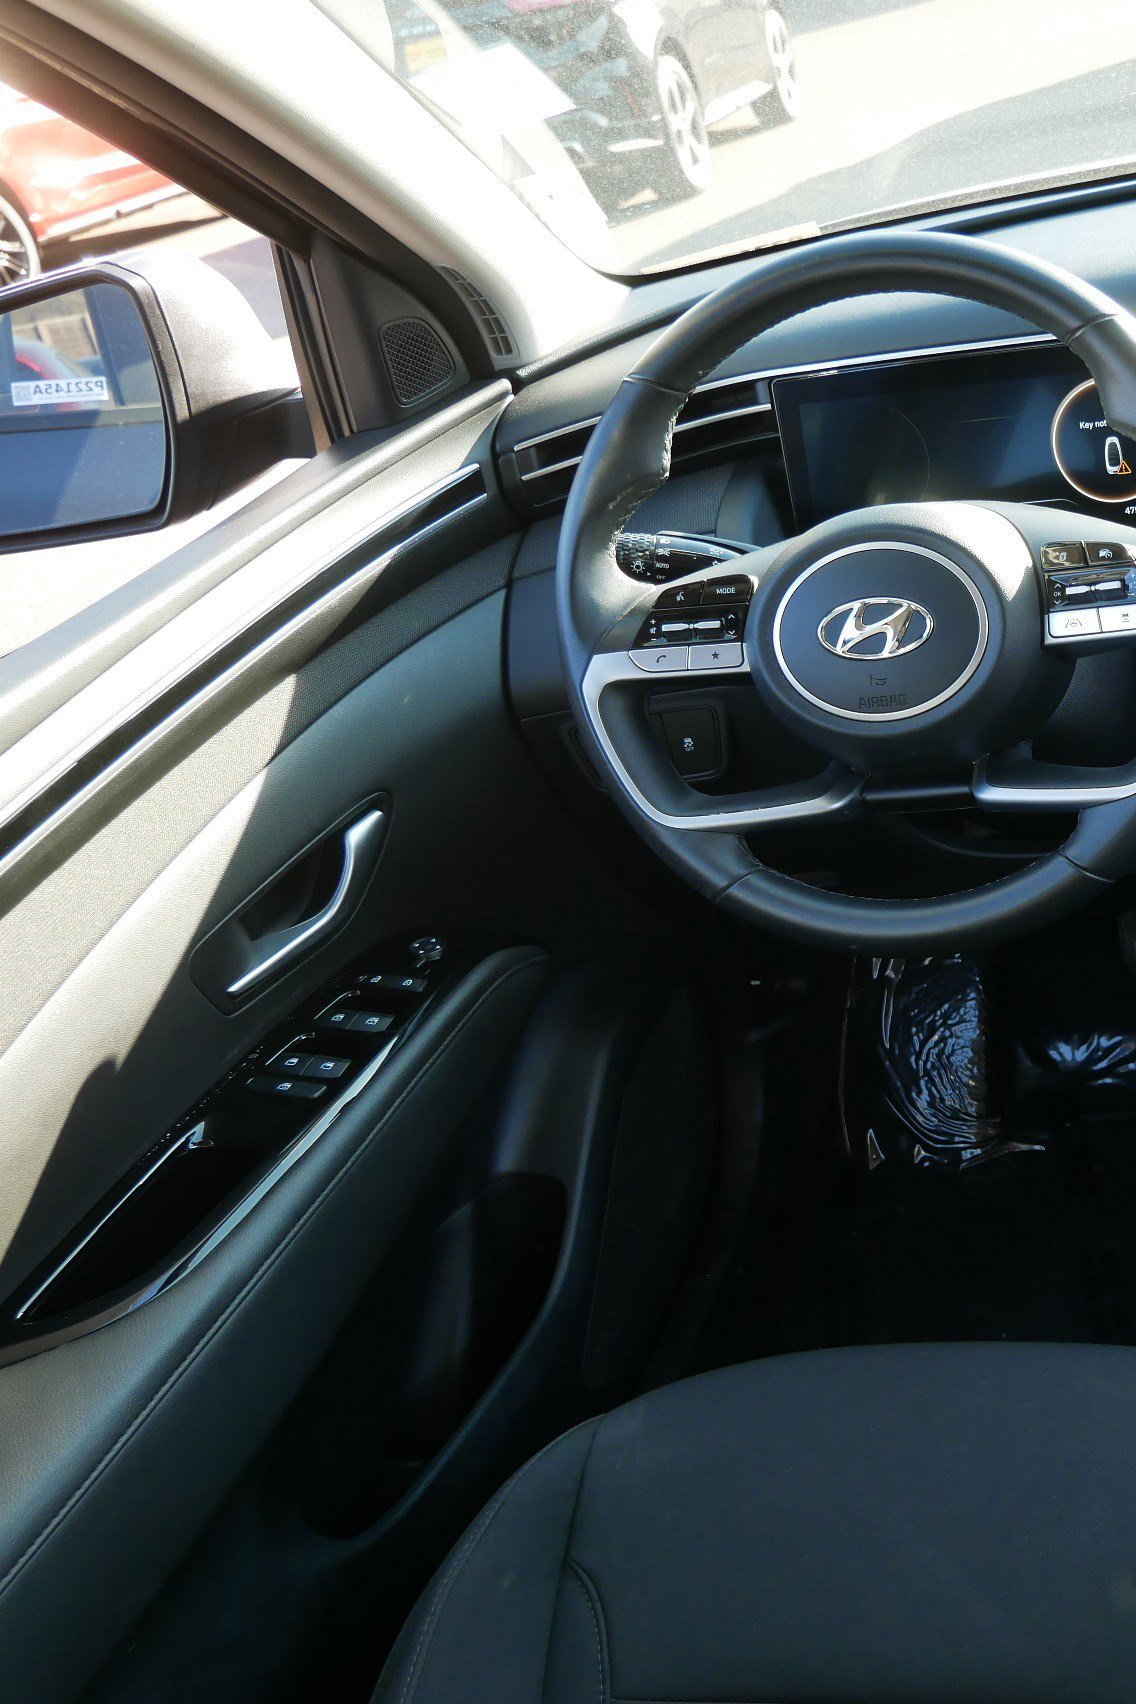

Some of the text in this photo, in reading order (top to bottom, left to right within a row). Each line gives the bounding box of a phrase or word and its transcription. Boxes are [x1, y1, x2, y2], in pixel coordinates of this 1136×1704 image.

[1079, 419, 1108, 430] Key not
[655, 561, 670, 570] AUTO
[716, 587, 736, 595] MODE
[1053, 590, 1062, 598] OK
[858, 693, 908, 710] AIRBAG
